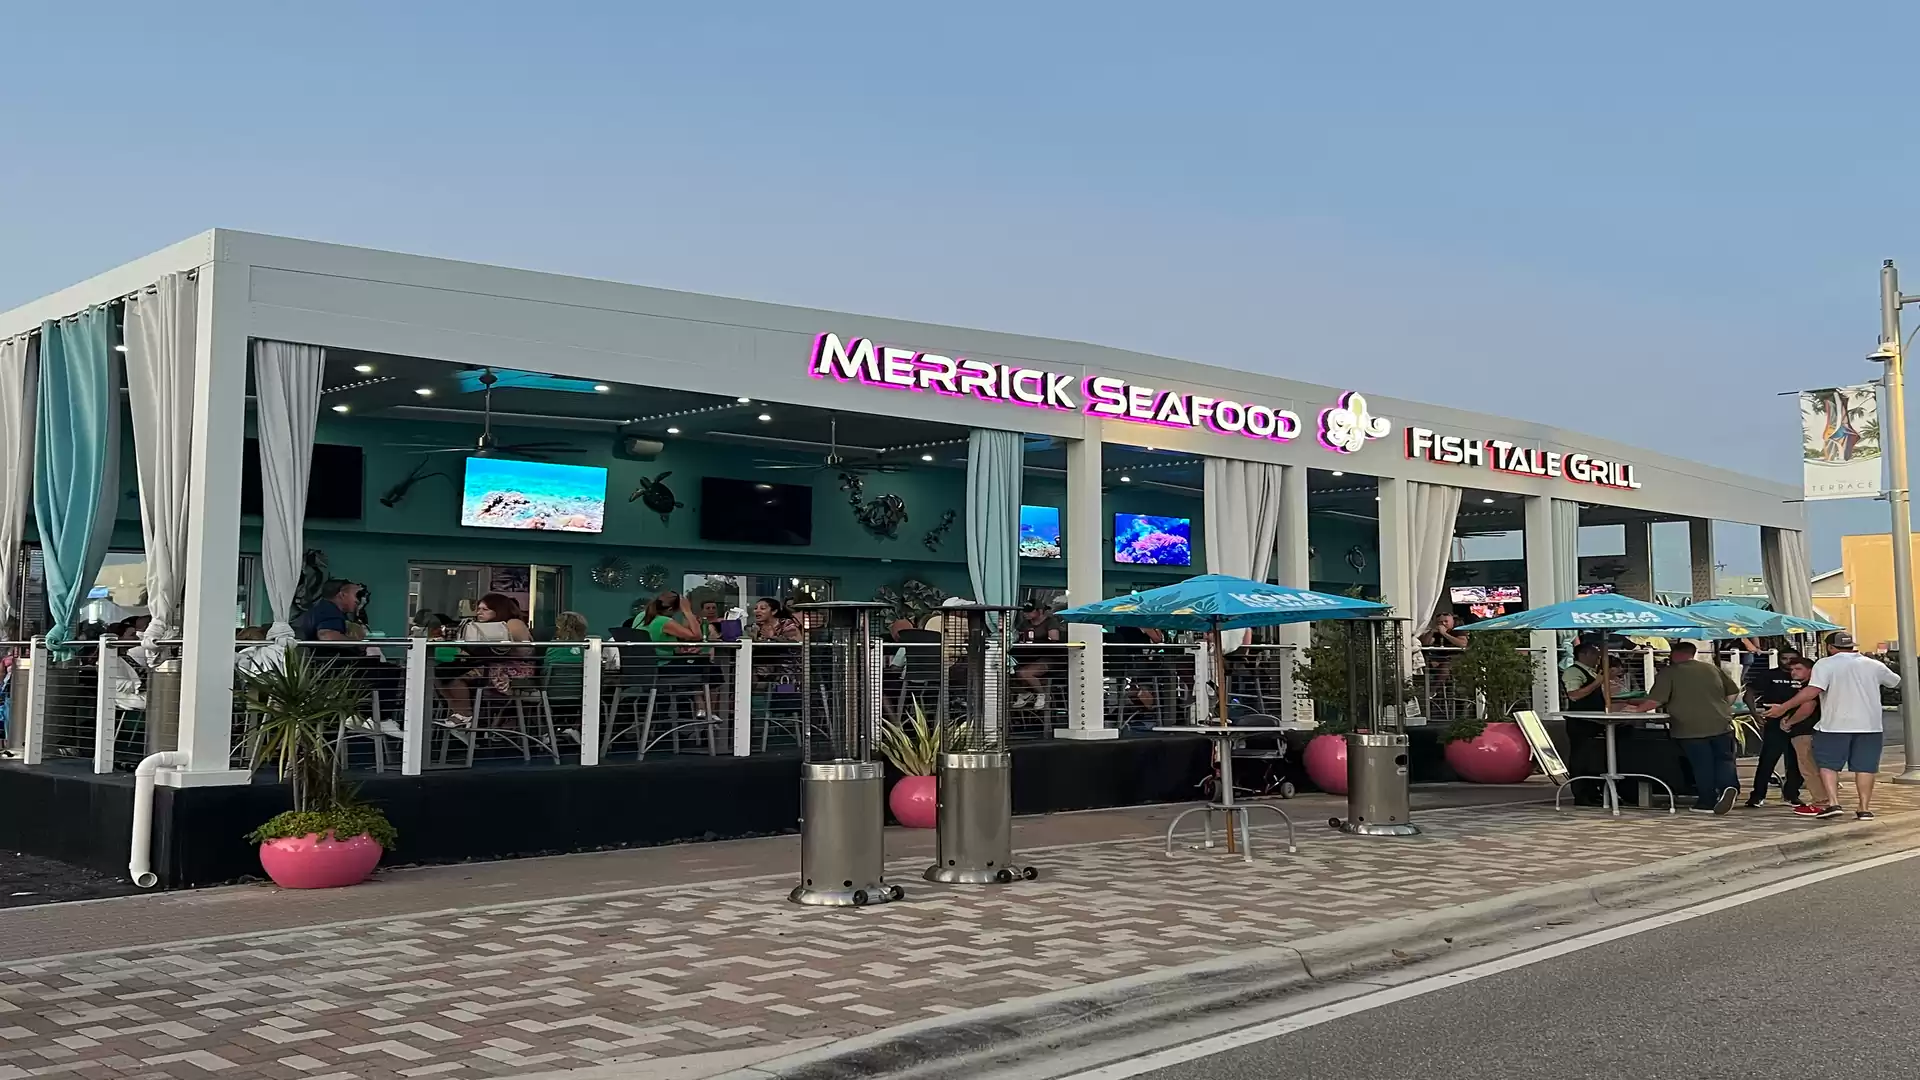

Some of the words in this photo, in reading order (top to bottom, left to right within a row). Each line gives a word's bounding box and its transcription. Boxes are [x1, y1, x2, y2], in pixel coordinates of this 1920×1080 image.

[813, 332, 1076, 409] MERRICK
[1090, 375, 1302, 440] SEAFOOD
[1410, 426, 1484, 466] FISH
[1492, 439, 1562, 478] TALE
[1569, 453, 1643, 489] GRILL
[1811, 481, 1873, 491] TERRACE
[1228, 592, 1327, 603] KONA
[1571, 611, 1656, 620] KONA
